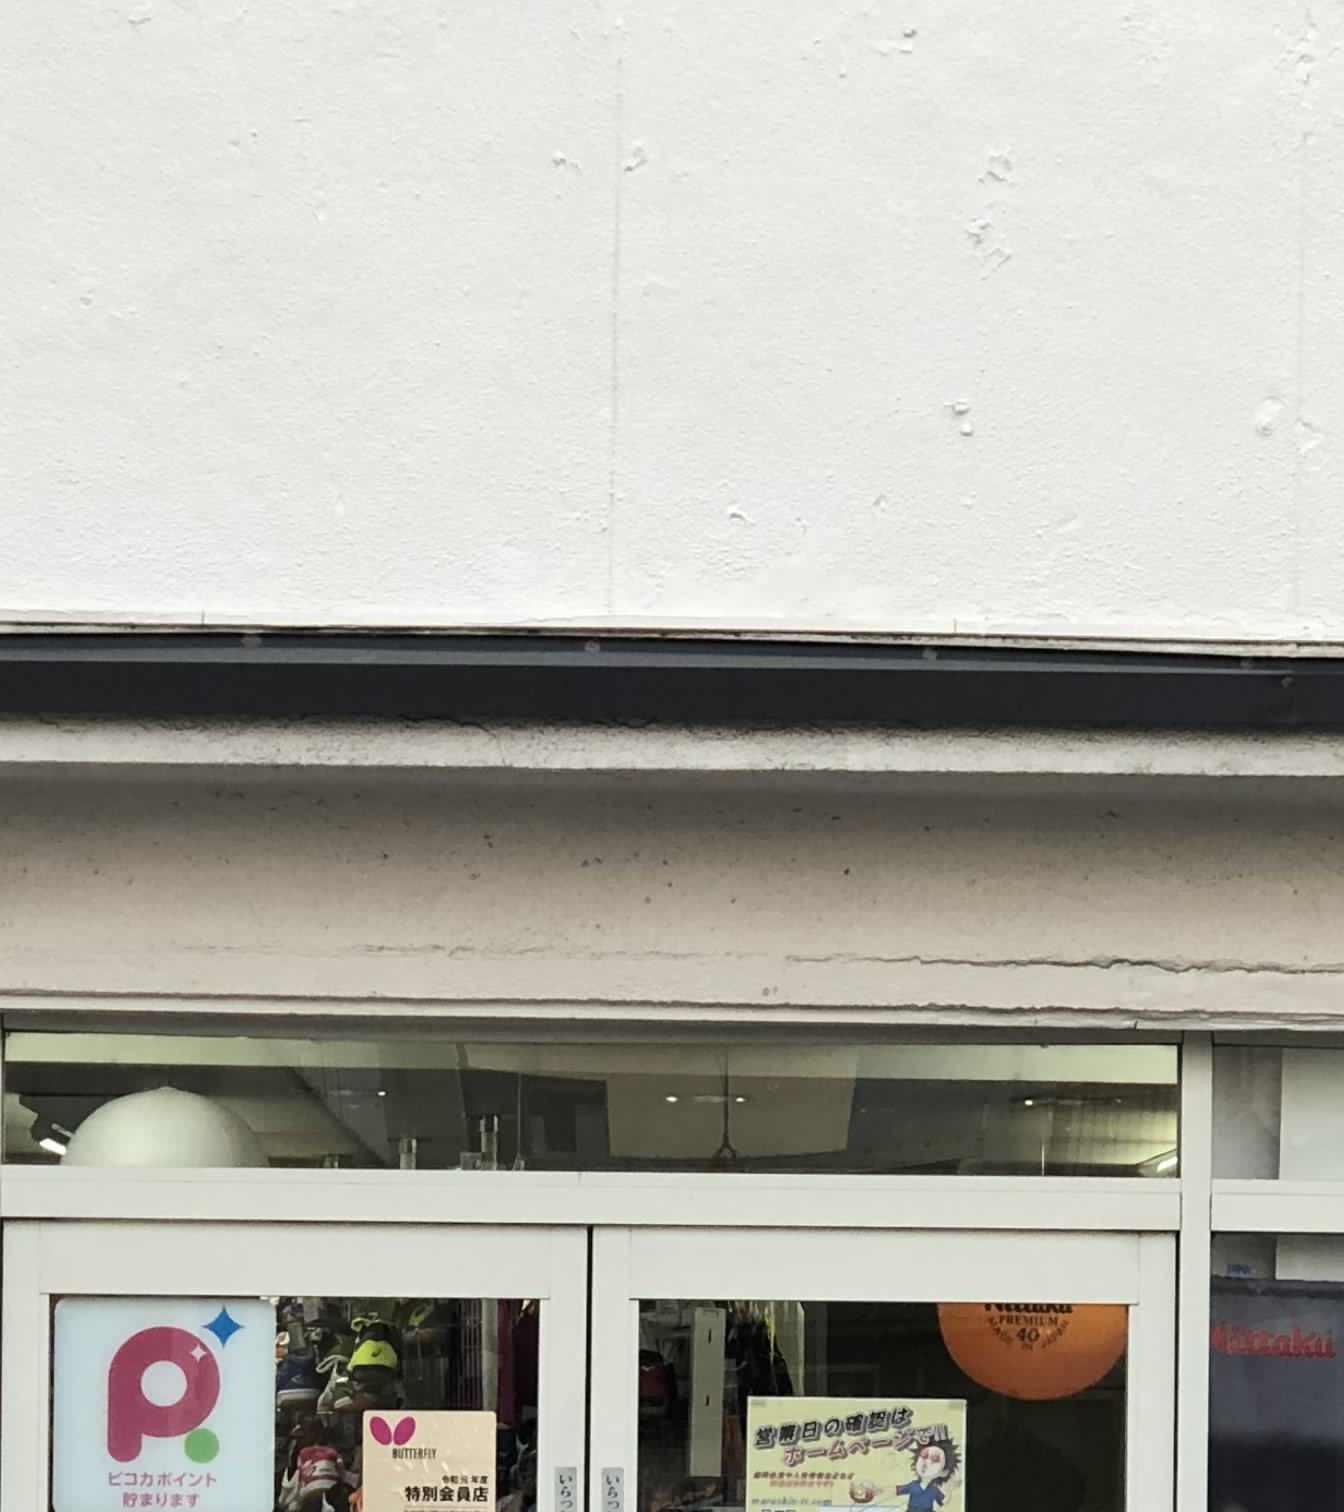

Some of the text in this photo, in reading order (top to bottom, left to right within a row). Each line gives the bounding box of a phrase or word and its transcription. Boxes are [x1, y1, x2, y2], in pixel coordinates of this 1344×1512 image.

[1016, 1328, 1040, 1342] 40
[754, 1408, 913, 1449] 営業日の確認は
[392, 1448, 437, 1460] BUTTERFLY
[123, 1493, 199, 1508] 貯まります
[404, 1486, 488, 1502] 特別会員店
